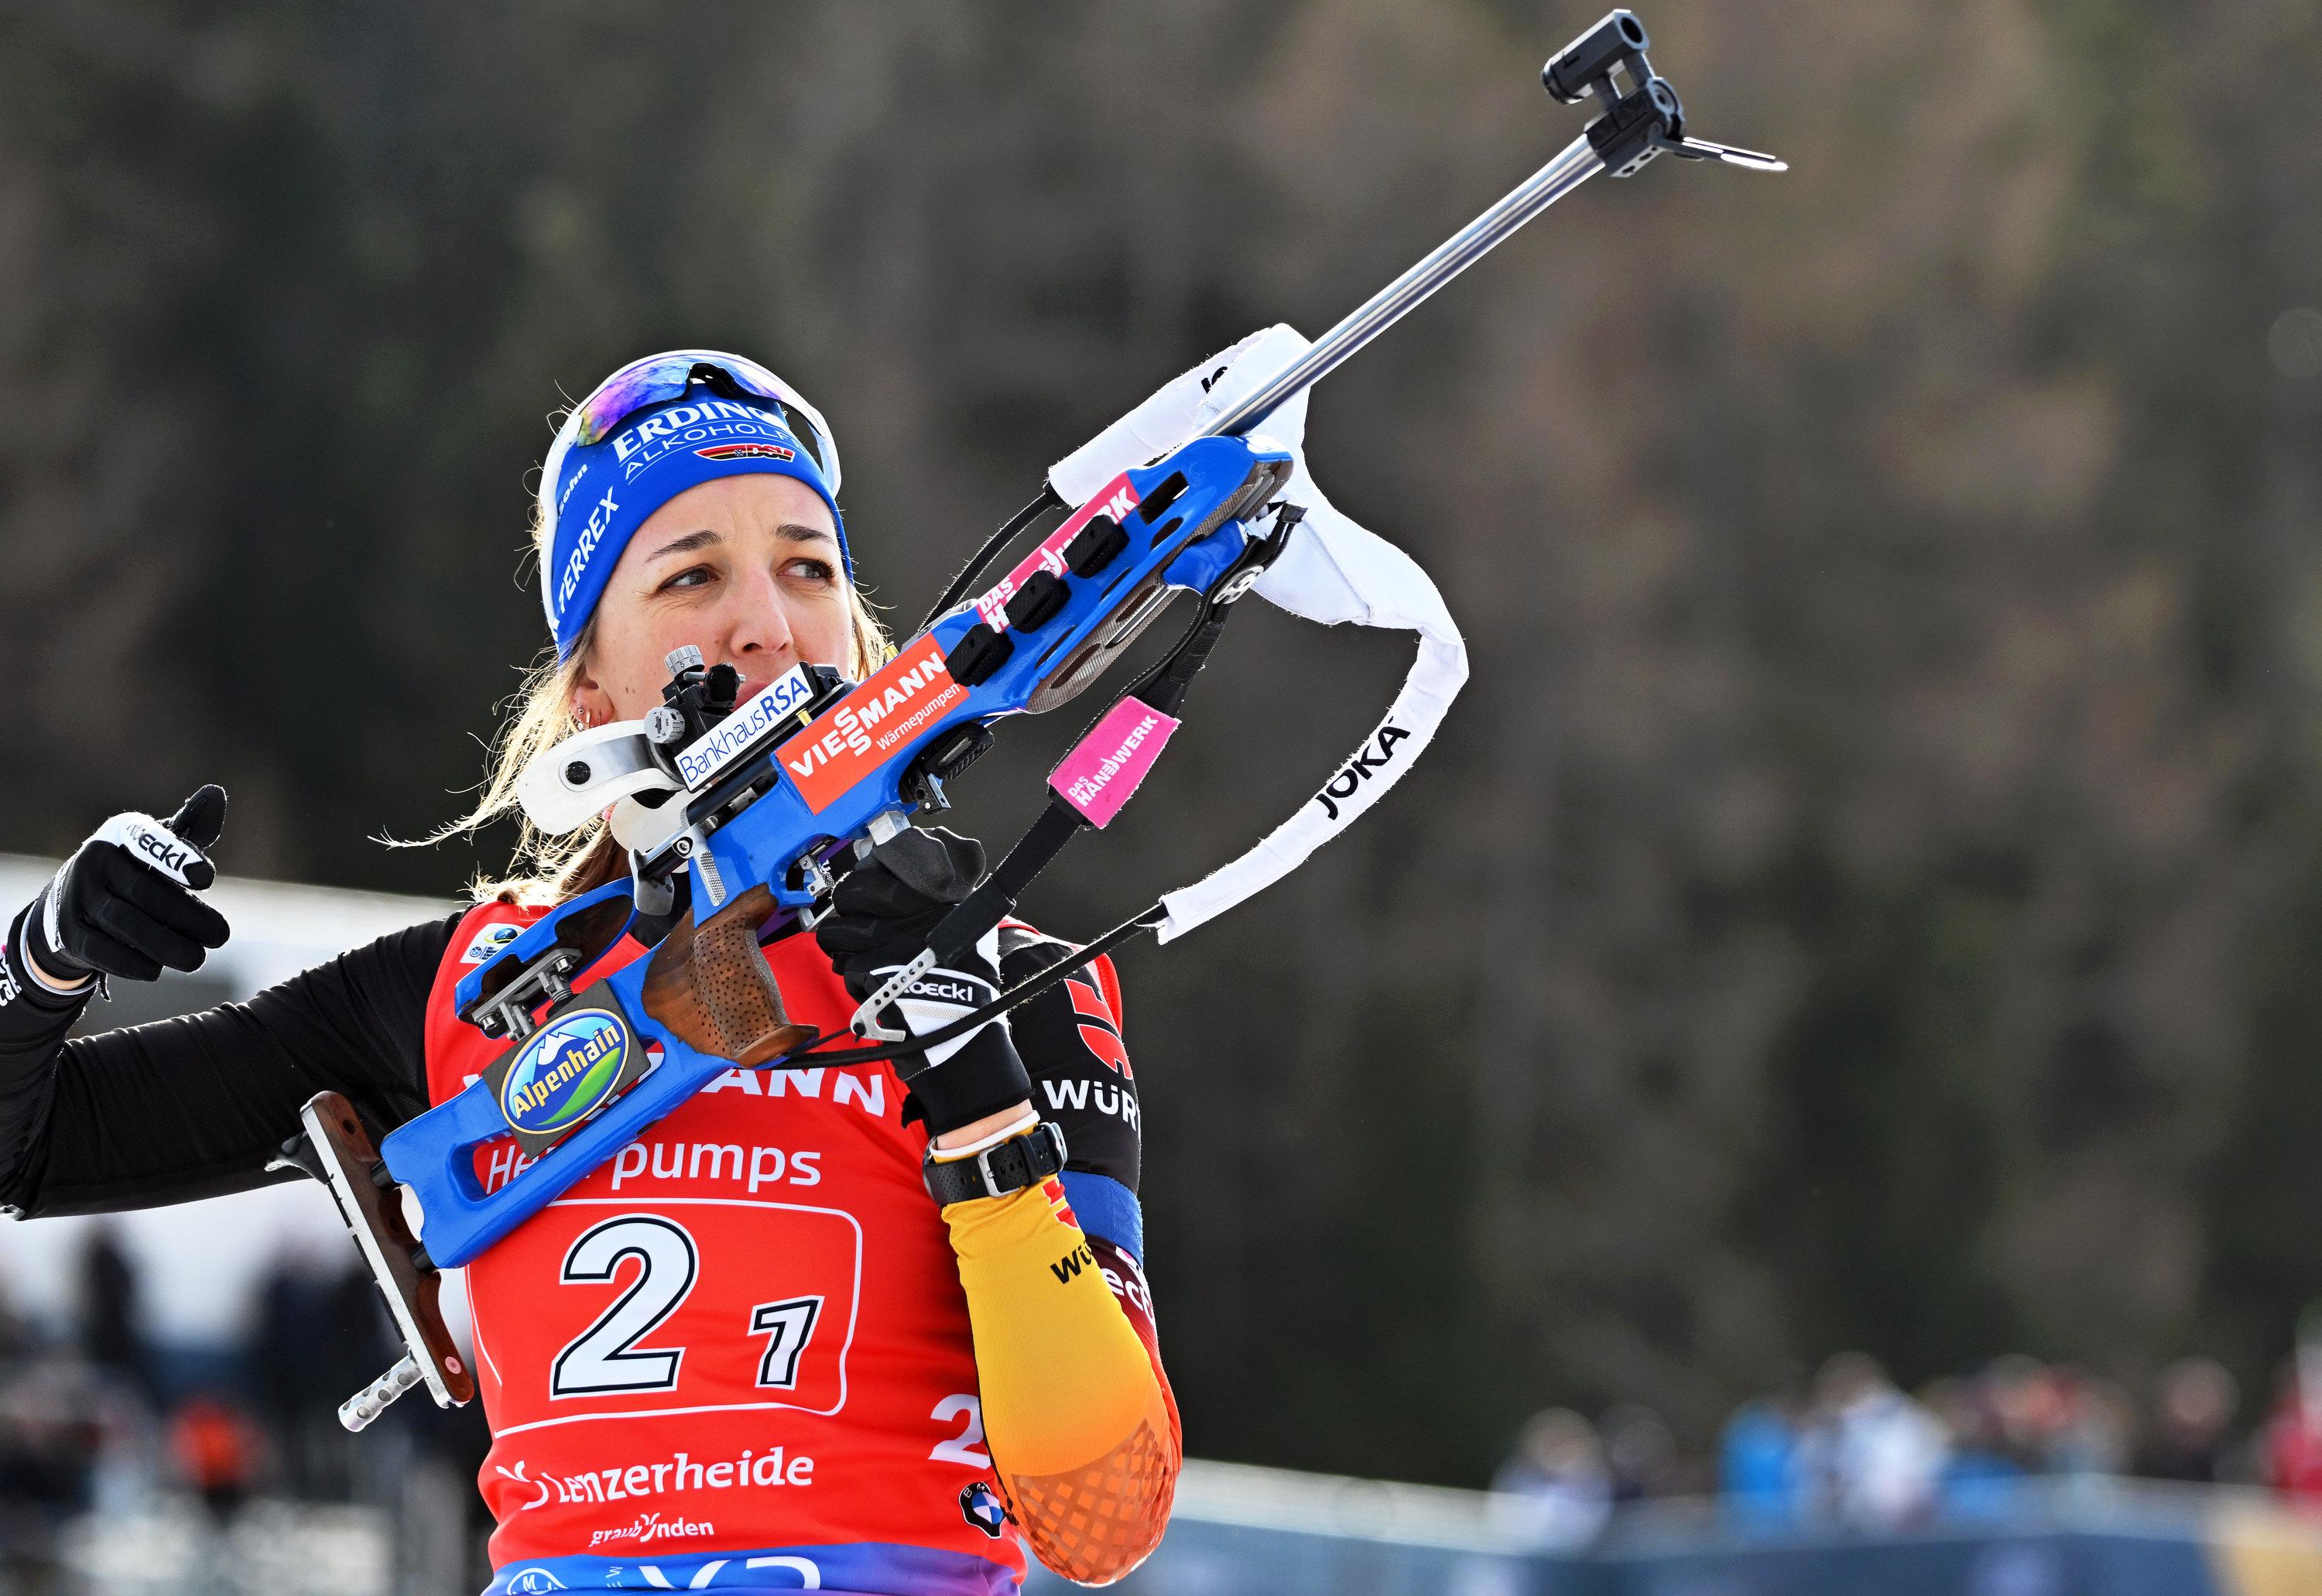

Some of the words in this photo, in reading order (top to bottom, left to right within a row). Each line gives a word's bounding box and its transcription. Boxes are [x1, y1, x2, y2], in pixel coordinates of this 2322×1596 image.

[559, 464, 588, 517] sohn
[559, 485, 620, 614] TERREX
[978, 577, 1014, 615] DAS
[789, 651, 946, 778] VIESSMANN
[875, 683, 961, 751] Wärmepumpen
[1067, 776, 1089, 797] DAS
[1314, 724, 1411, 820] JOKA
[512, 1024, 621, 1120] Alpenhain
[1042, 1079, 1141, 1141] WÜR
[611, 1142, 821, 1193] pumps
[550, 1212, 699, 1401] 2
[747, 1295, 826, 1392] 1
[928, 1394, 991, 1470] 2
[541, 1447, 814, 1503] Lenzerheide
